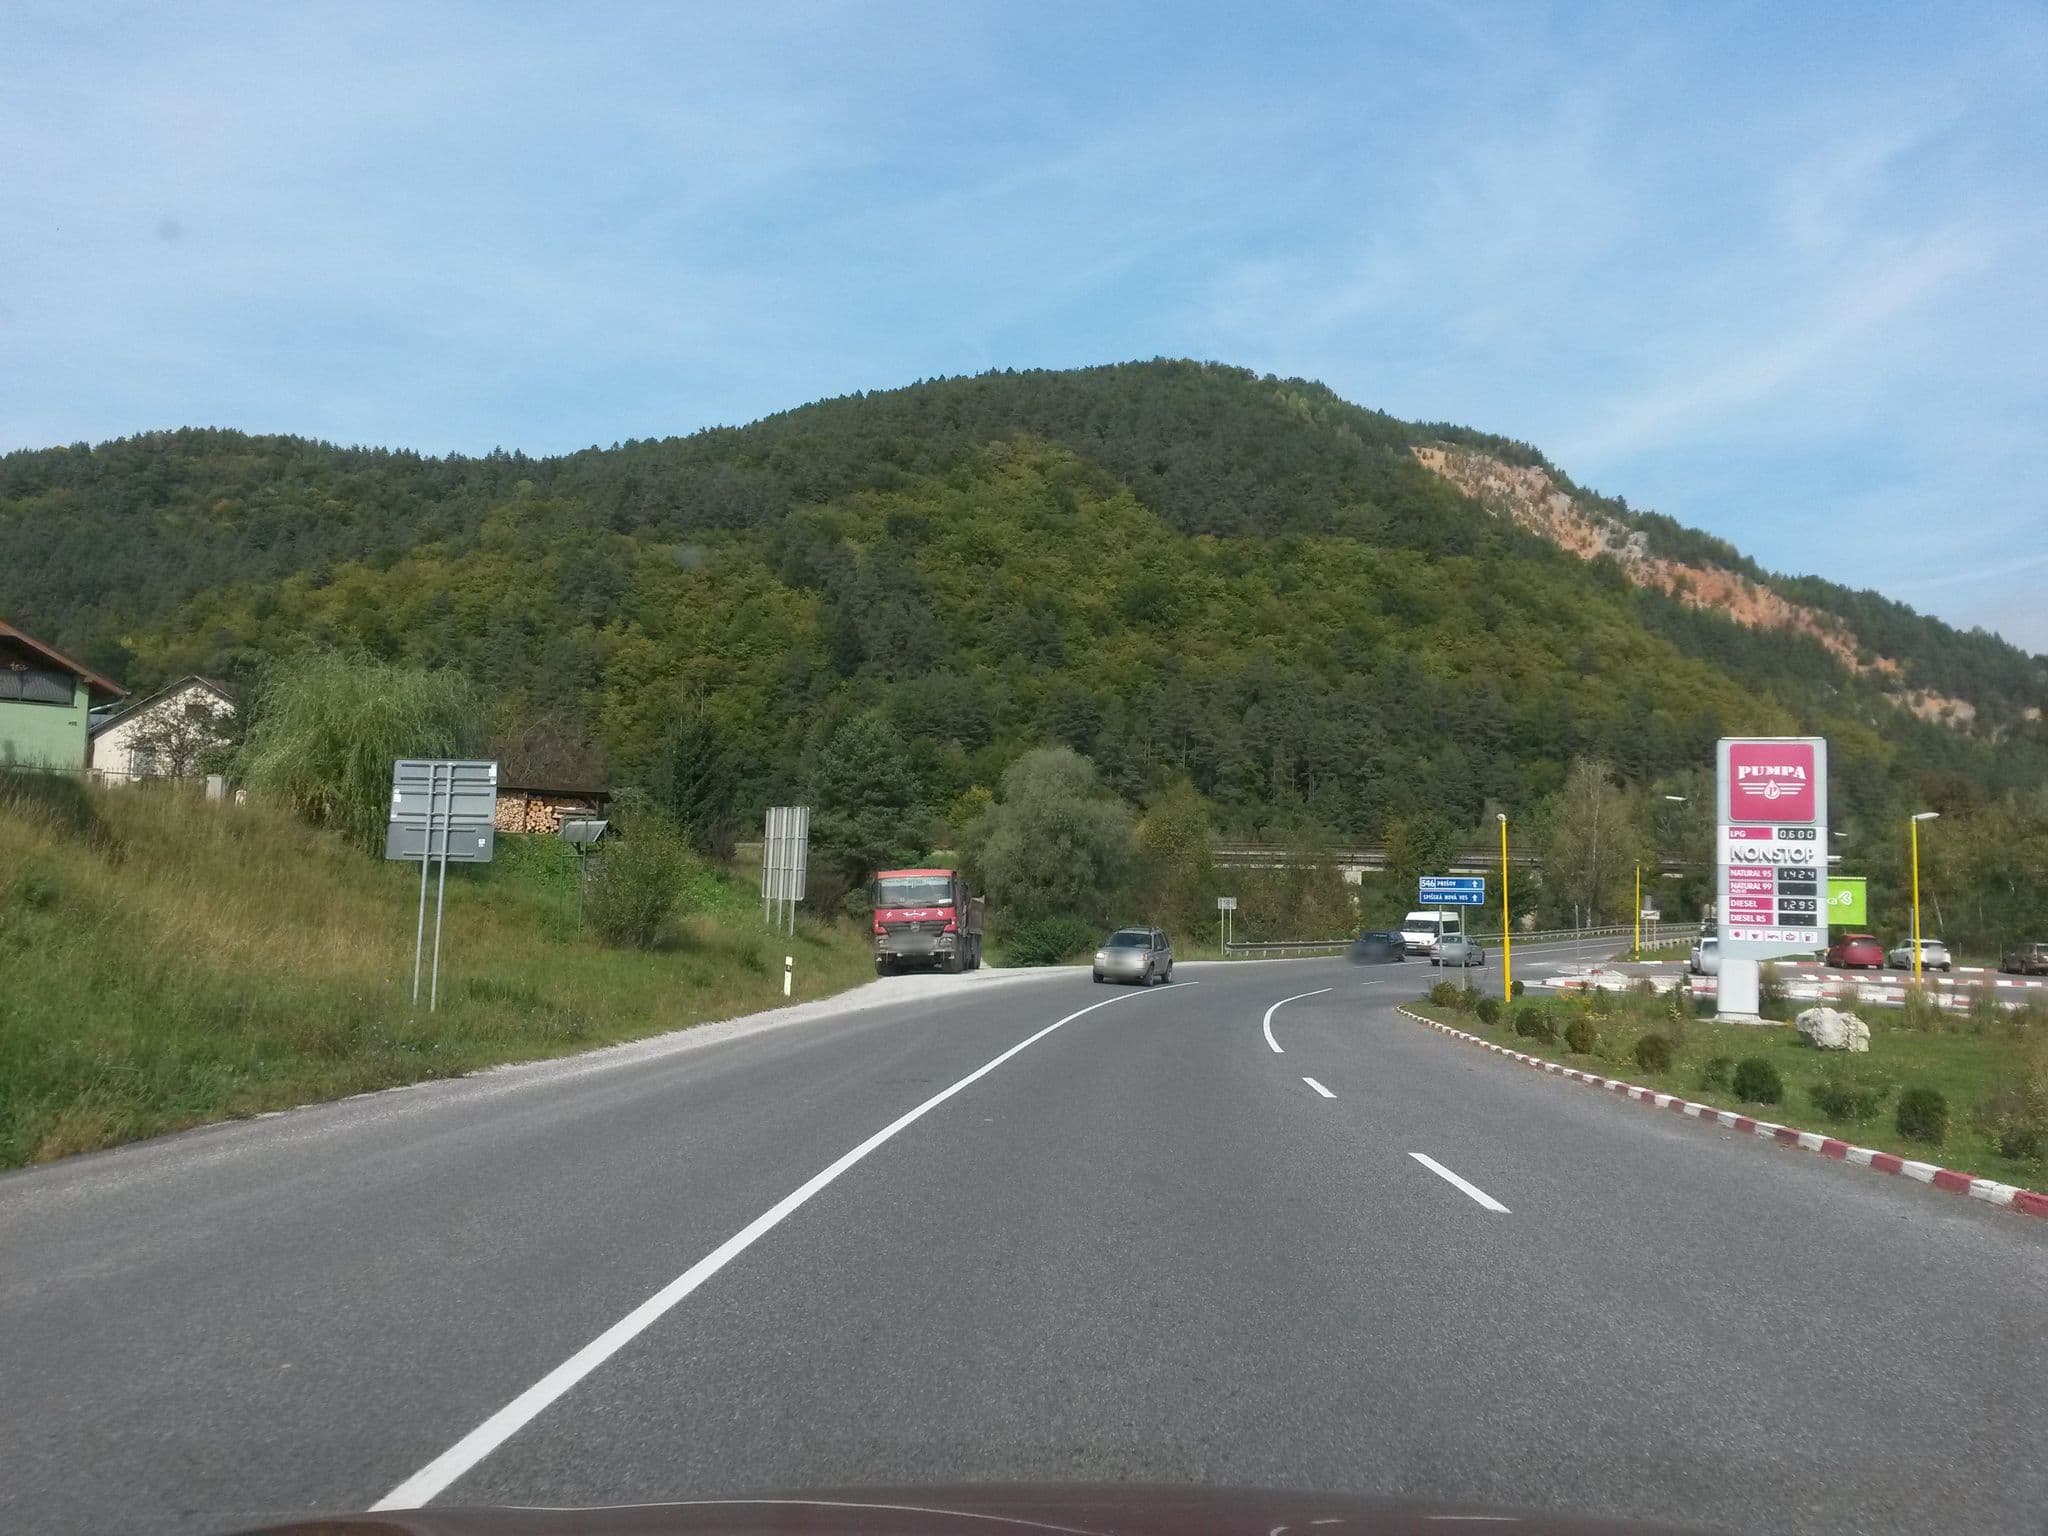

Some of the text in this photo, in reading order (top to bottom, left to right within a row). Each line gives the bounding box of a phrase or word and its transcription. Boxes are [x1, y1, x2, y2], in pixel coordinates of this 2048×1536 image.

[1738, 766, 1806, 779] PUMPA
[1730, 848, 1815, 864] NONSTOP
[1730, 869, 1761, 877] NATURAL
